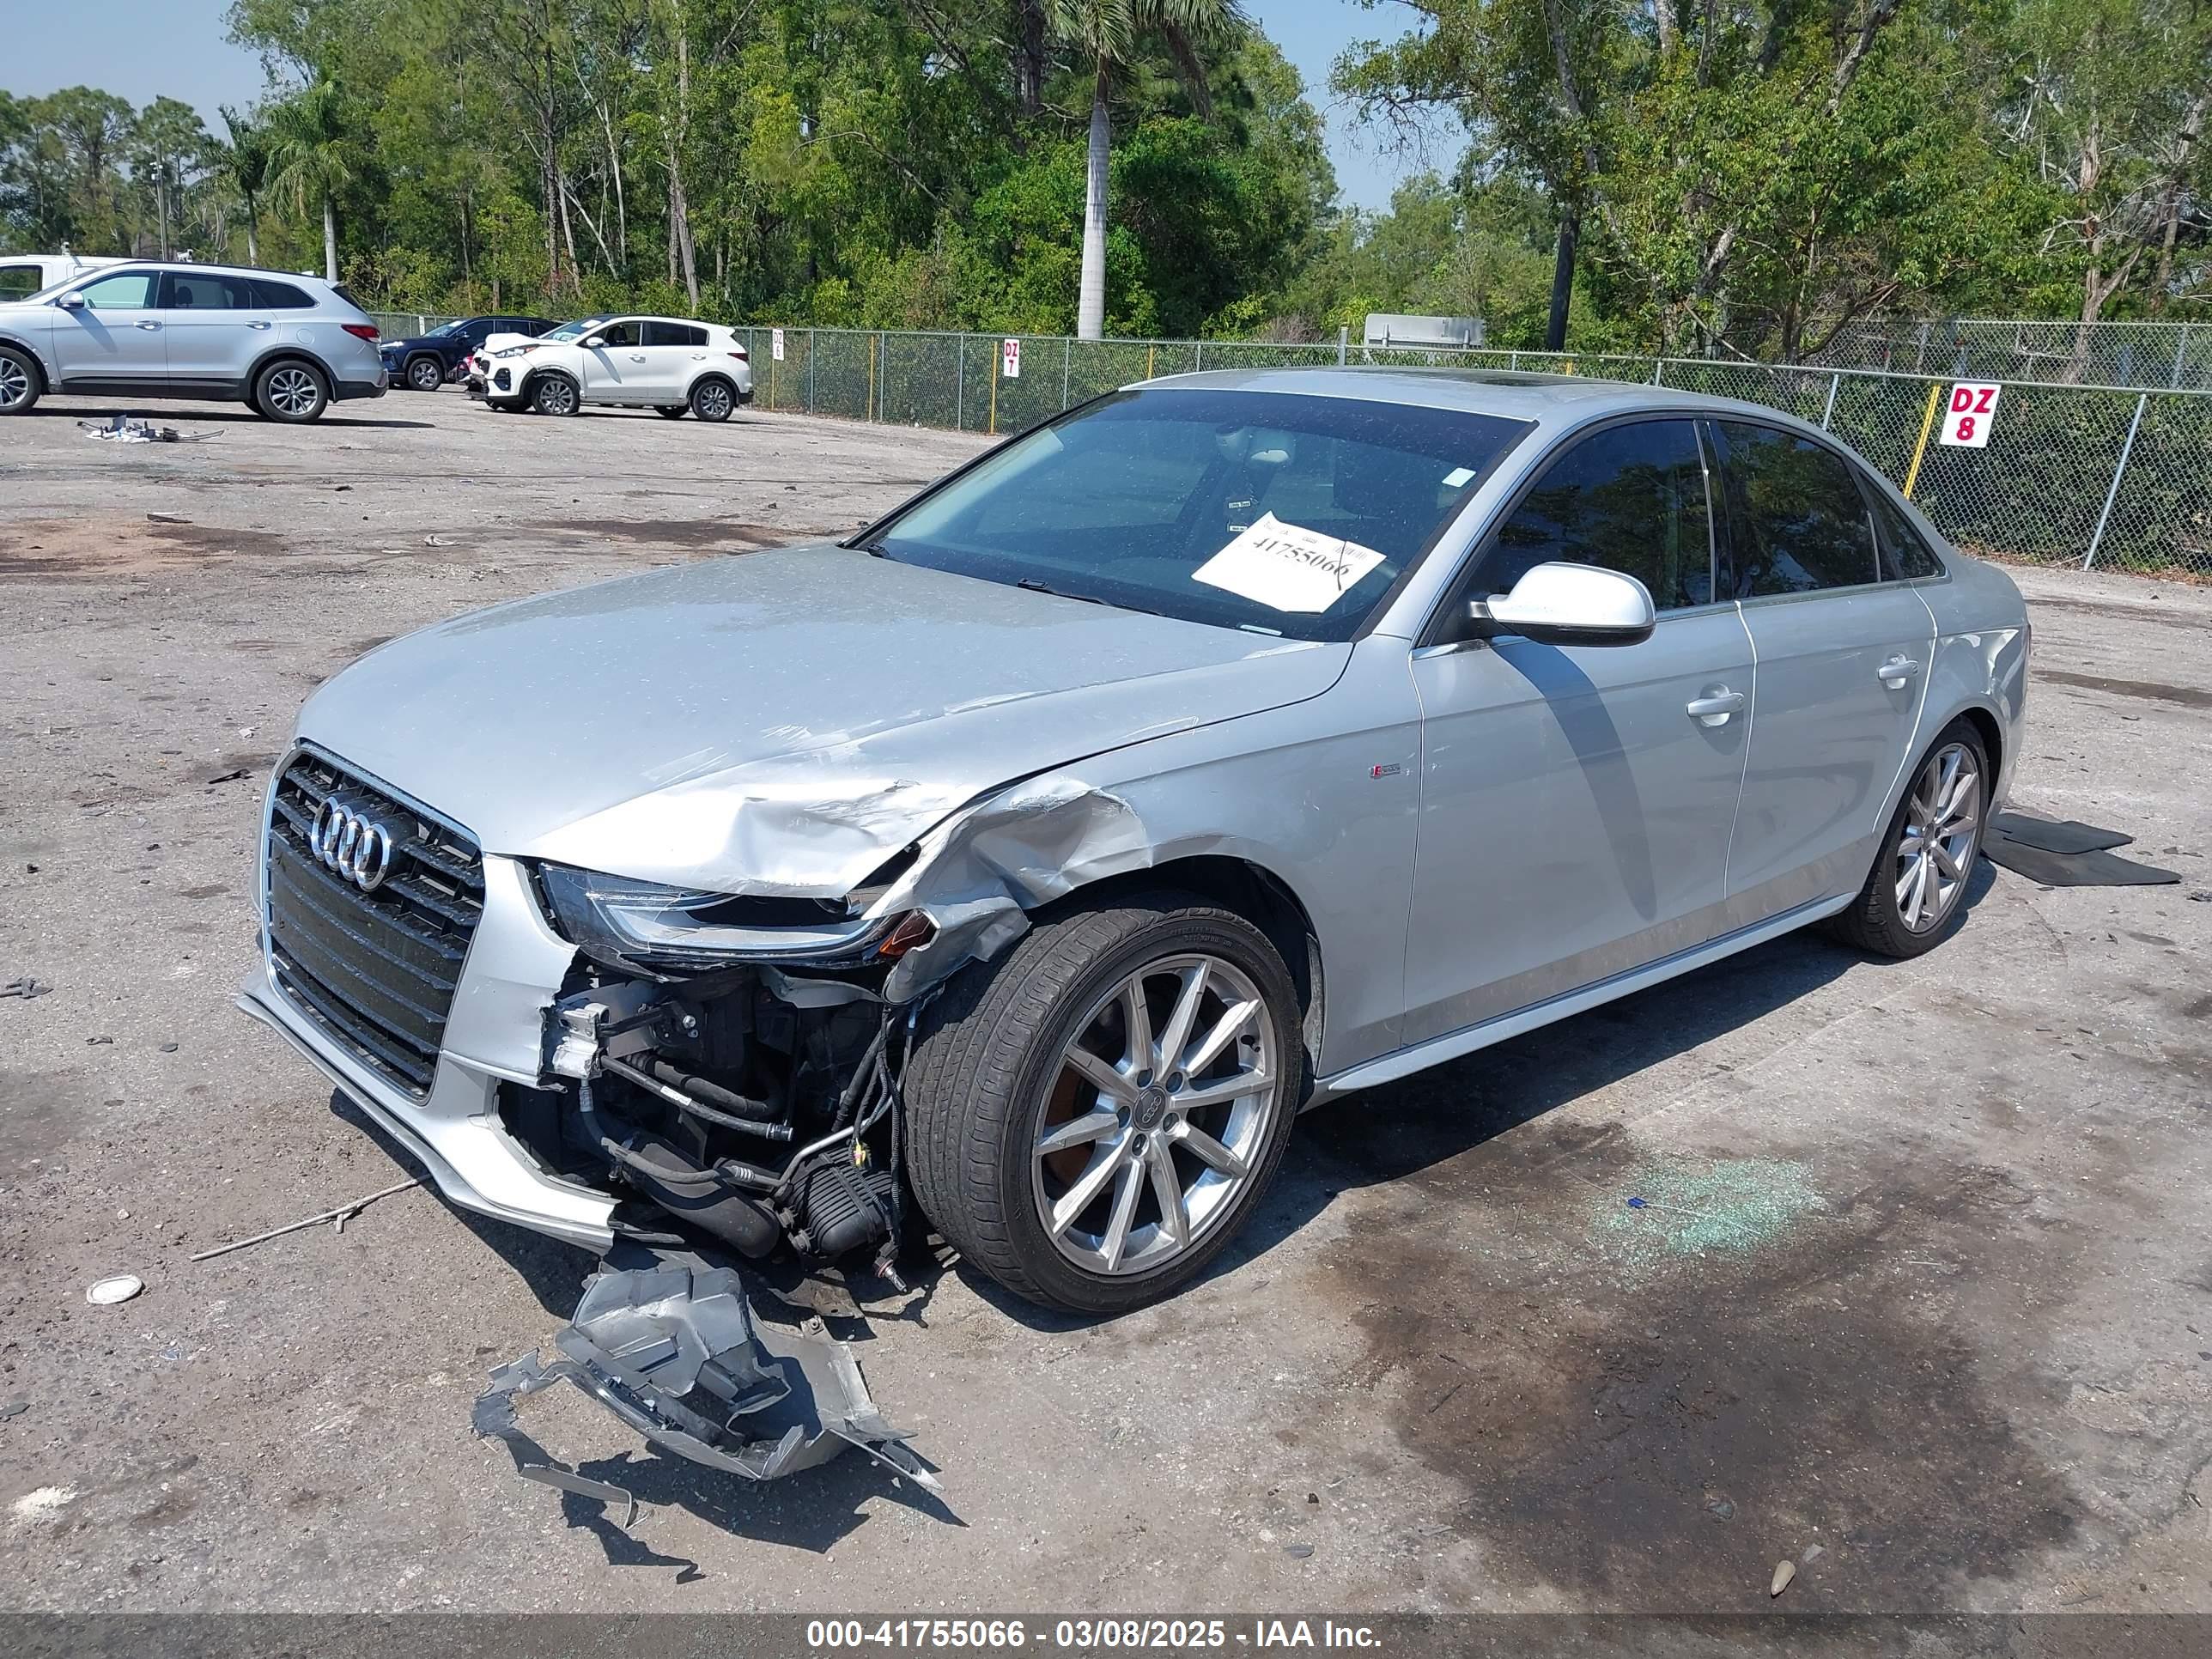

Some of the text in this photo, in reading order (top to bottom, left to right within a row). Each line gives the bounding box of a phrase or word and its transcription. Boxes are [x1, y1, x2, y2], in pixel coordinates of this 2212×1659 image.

[1006, 342, 1018, 357] DZ
[1008, 359, 1014, 374] 7
[1951, 388, 1997, 414] DZ
[1956, 416, 1976, 441] 8
[1253, 537, 1353, 576] 41755066
